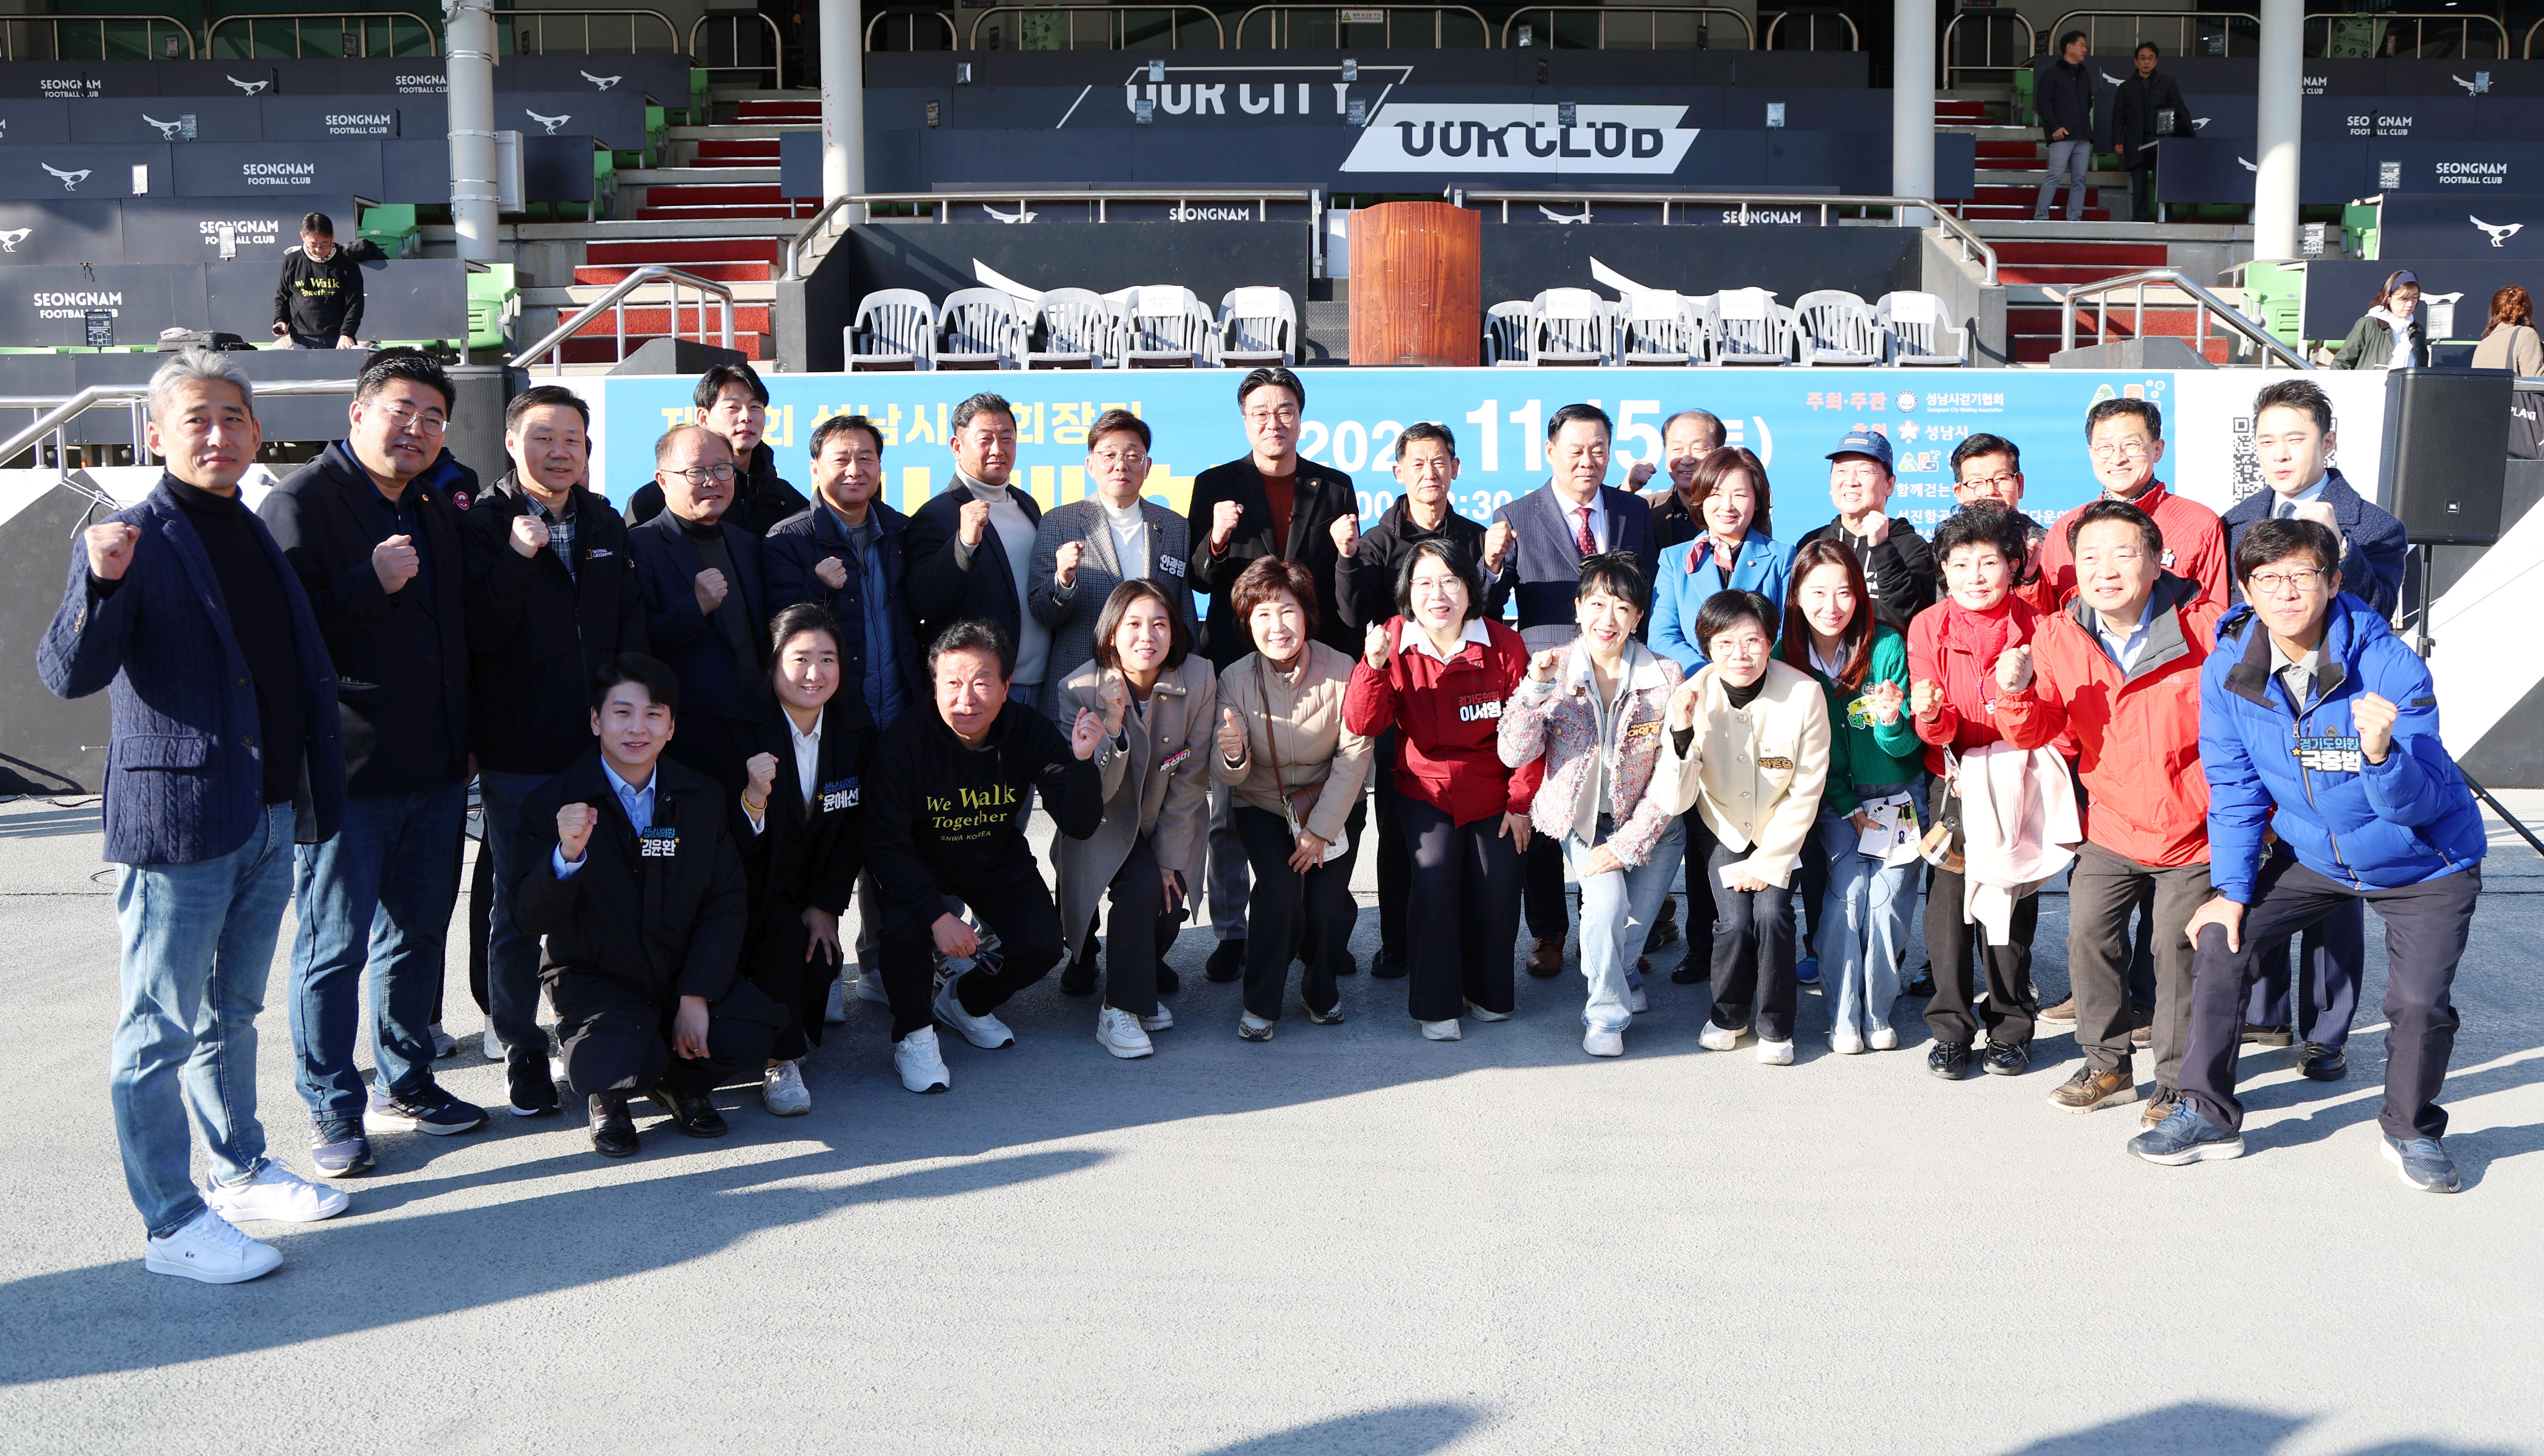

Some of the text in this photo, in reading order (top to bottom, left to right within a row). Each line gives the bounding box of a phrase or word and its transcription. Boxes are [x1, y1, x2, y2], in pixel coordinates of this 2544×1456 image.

[395, 75, 447, 85] SEONGNA
[325, 114, 390, 125] SEONGNAM
[2347, 116, 2412, 126] SEOGNAM
[243, 163, 314, 175] SEONGNAM
[2436, 163, 2507, 174] SEONGNAM
[253, 235, 275, 244] CLUB
[310, 278, 340, 288] Walk
[34, 292, 122, 307] SEONGNAM
[301, 288, 335, 297] Together
[1807, 392, 1887, 410] 주최·주관
[1925, 393, 2004, 407] 성남시걷기협회
[1925, 425, 1968, 441] 성남시
[1160, 553, 1186, 578] 안광림
[1458, 691, 1499, 706] 경기도의원
[1460, 701, 1502, 722] 이서영
[2300, 737, 2360, 751] 경기도의원
[2301, 750, 2362, 772] 국중범
[824, 776, 859, 795] 성남시의원
[823, 788, 860, 813] 윤혜선
[926, 784, 1017, 812] We Walk
[933, 810, 1007, 831] Together
[644, 827, 676, 839] 성남시의원
[967, 830, 991, 840] KOREA
[641, 839, 676, 857] 김윤환
